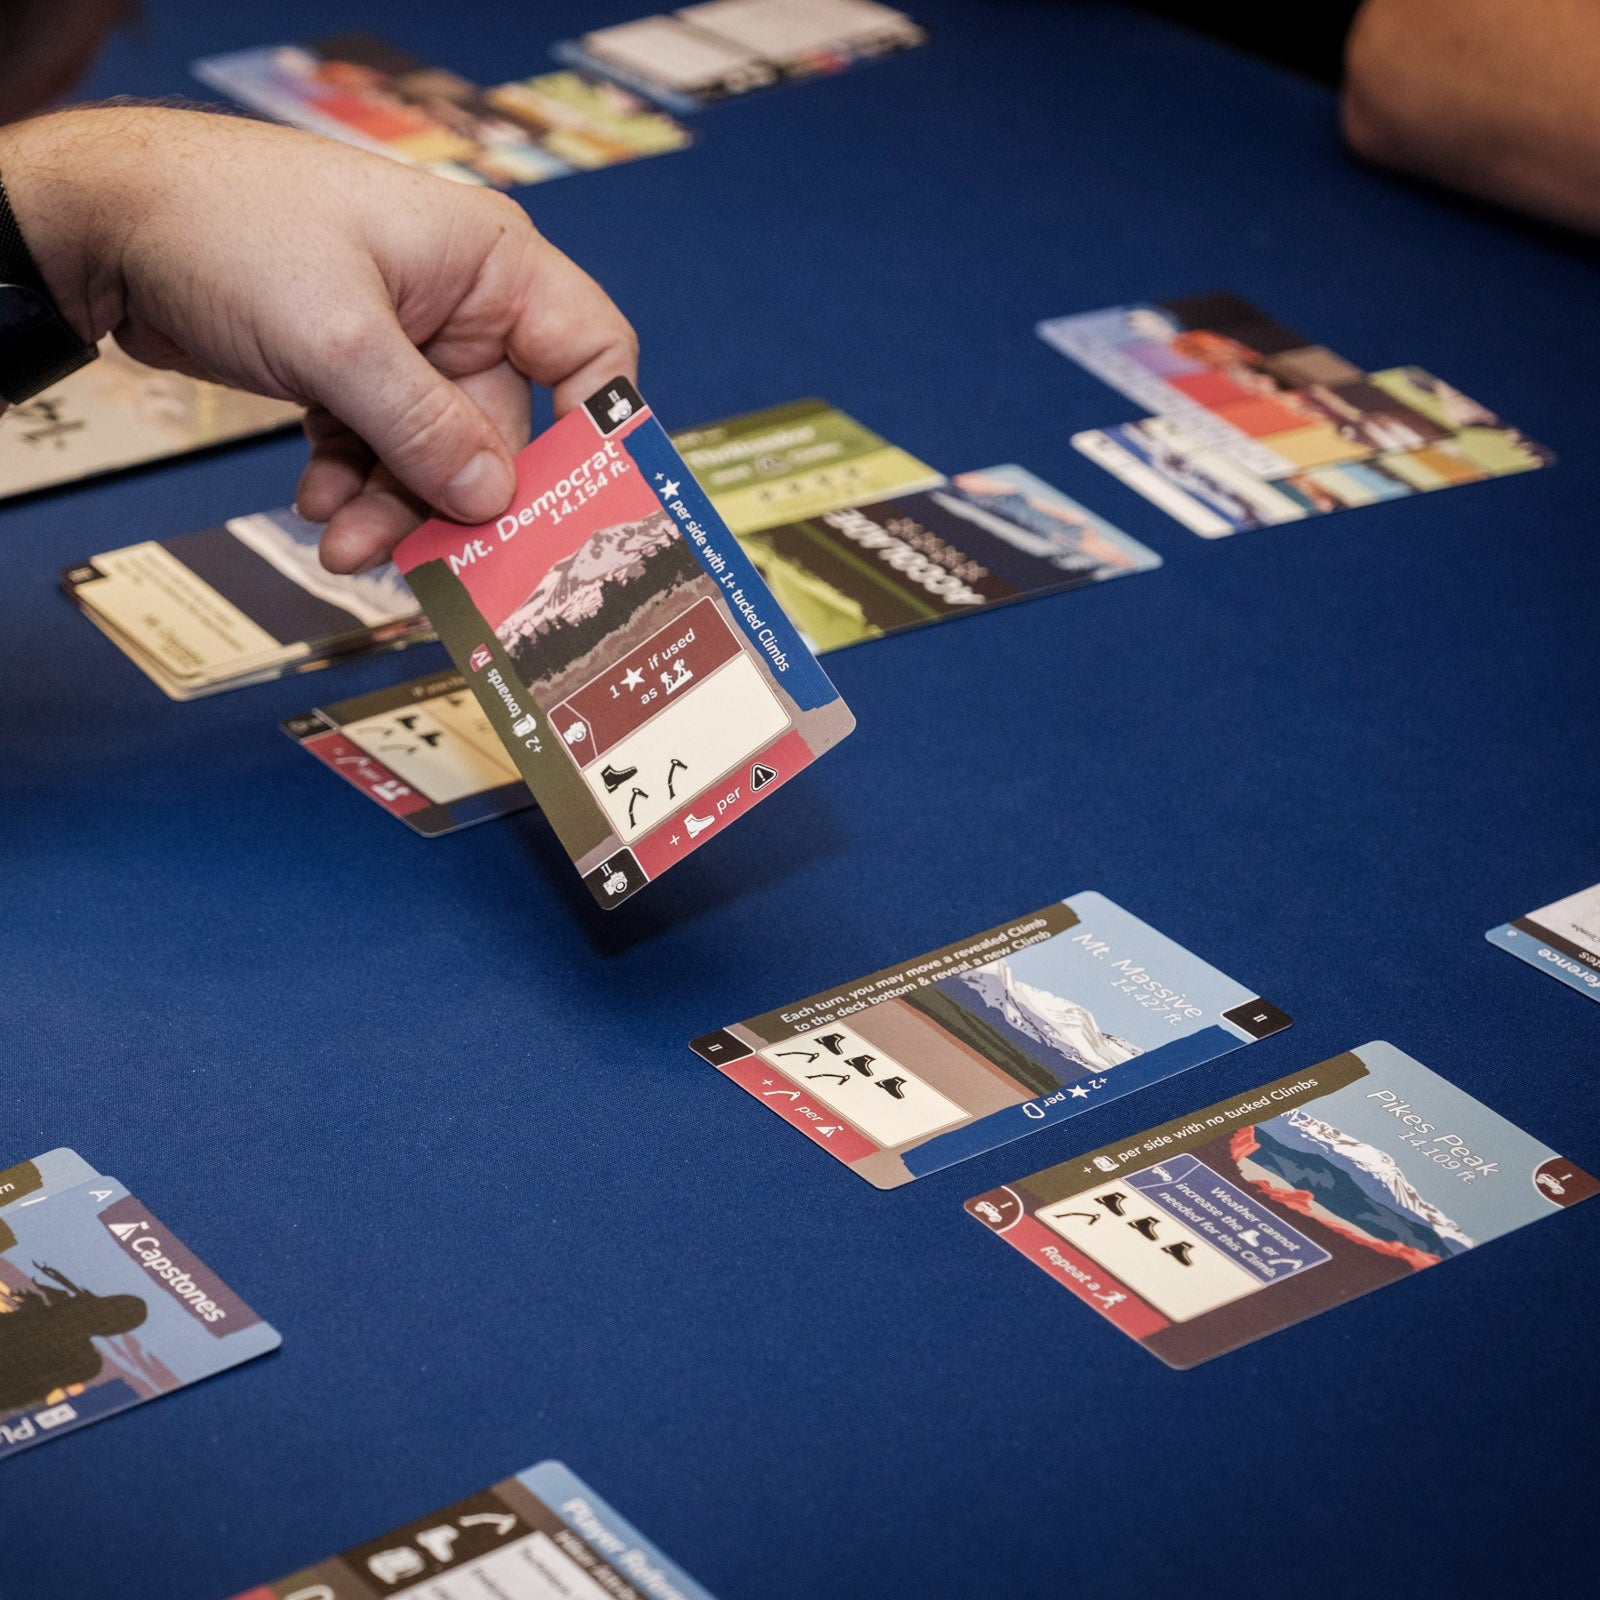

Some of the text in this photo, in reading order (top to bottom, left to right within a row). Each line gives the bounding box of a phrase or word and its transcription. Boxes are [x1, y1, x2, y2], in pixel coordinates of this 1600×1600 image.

[449, 539, 493, 576] Mt.
[496, 440, 619, 541] Democrat
[549, 460, 631, 525] 14,154 ft.
[669, 500, 691, 521] per
[685, 523, 707, 546] side
[702, 545, 727, 574] with
[719, 572, 736, 589] 1+
[731, 589, 766, 630] tucked
[758, 629, 790, 673] Climbs
[487, 668, 522, 718] towards
[609, 628, 695, 699] 1 if used
[641, 688, 658, 704] as
[525, 735, 543, 753] +2
[716, 786, 742, 815] per
[780, 917, 1048, 1024] Each turn, you may move a revealed Climb
[794, 930, 1051, 1033] to the deck bottom & reveal a new Climb
[1071, 933, 1203, 1019] Mt. Massive
[1110, 978, 1183, 1026] 14,427 ft.
[794, 1106, 824, 1121] per
[1043, 1076, 1108, 1108] +2 per
[1118, 1148, 1140, 1163] per
[1143, 1134, 1173, 1152] side
[1173, 1121, 1206, 1139] with
[1205, 1115, 1225, 1127] no
[1224, 1096, 1271, 1119] tucked
[1270, 1077, 1318, 1101] Climbs
[1366, 1090, 1500, 1177] Pikes Peak
[1397, 1131, 1479, 1185] 14,109 ft.
[89, 1189, 113, 1203] A
[1175, 1183, 1279, 1258] increase the or
[1211, 1186, 1300, 1253] Weather cannot
[1040, 1245, 1100, 1291] Repeat a
[1158, 1192, 1276, 1279] needed for this Climb.
[131, 1236, 227, 1323] Capstones
